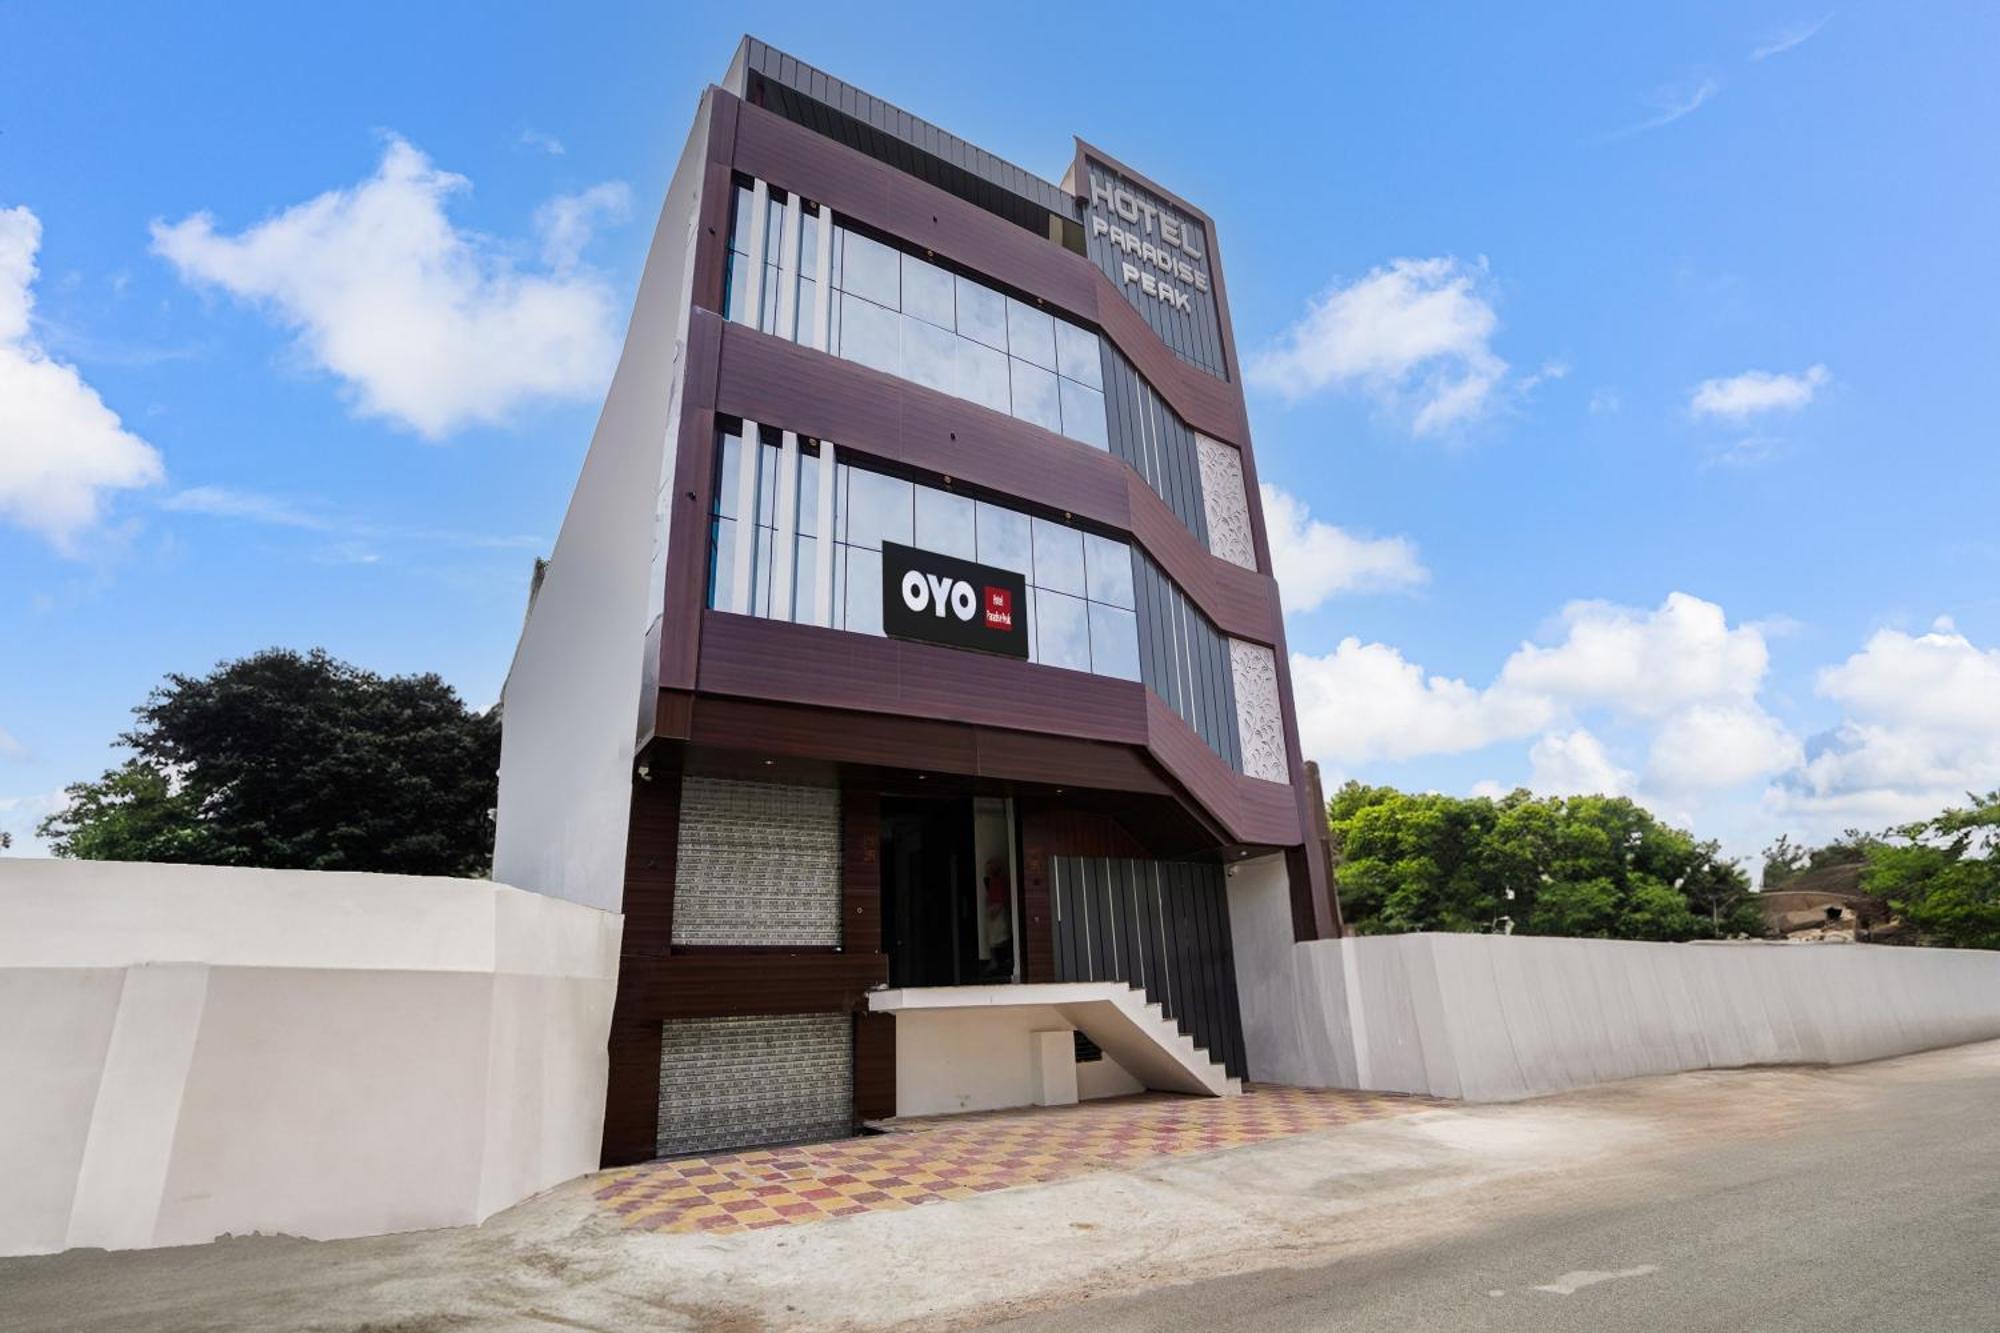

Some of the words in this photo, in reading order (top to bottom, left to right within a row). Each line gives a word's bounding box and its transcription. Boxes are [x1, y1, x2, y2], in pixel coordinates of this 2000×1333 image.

[1089, 174, 1201, 261] HOTEL
[1092, 215, 1208, 293] PARADISE
[1122, 262, 1191, 314] PEAK
[902, 570, 977, 622] OYO
